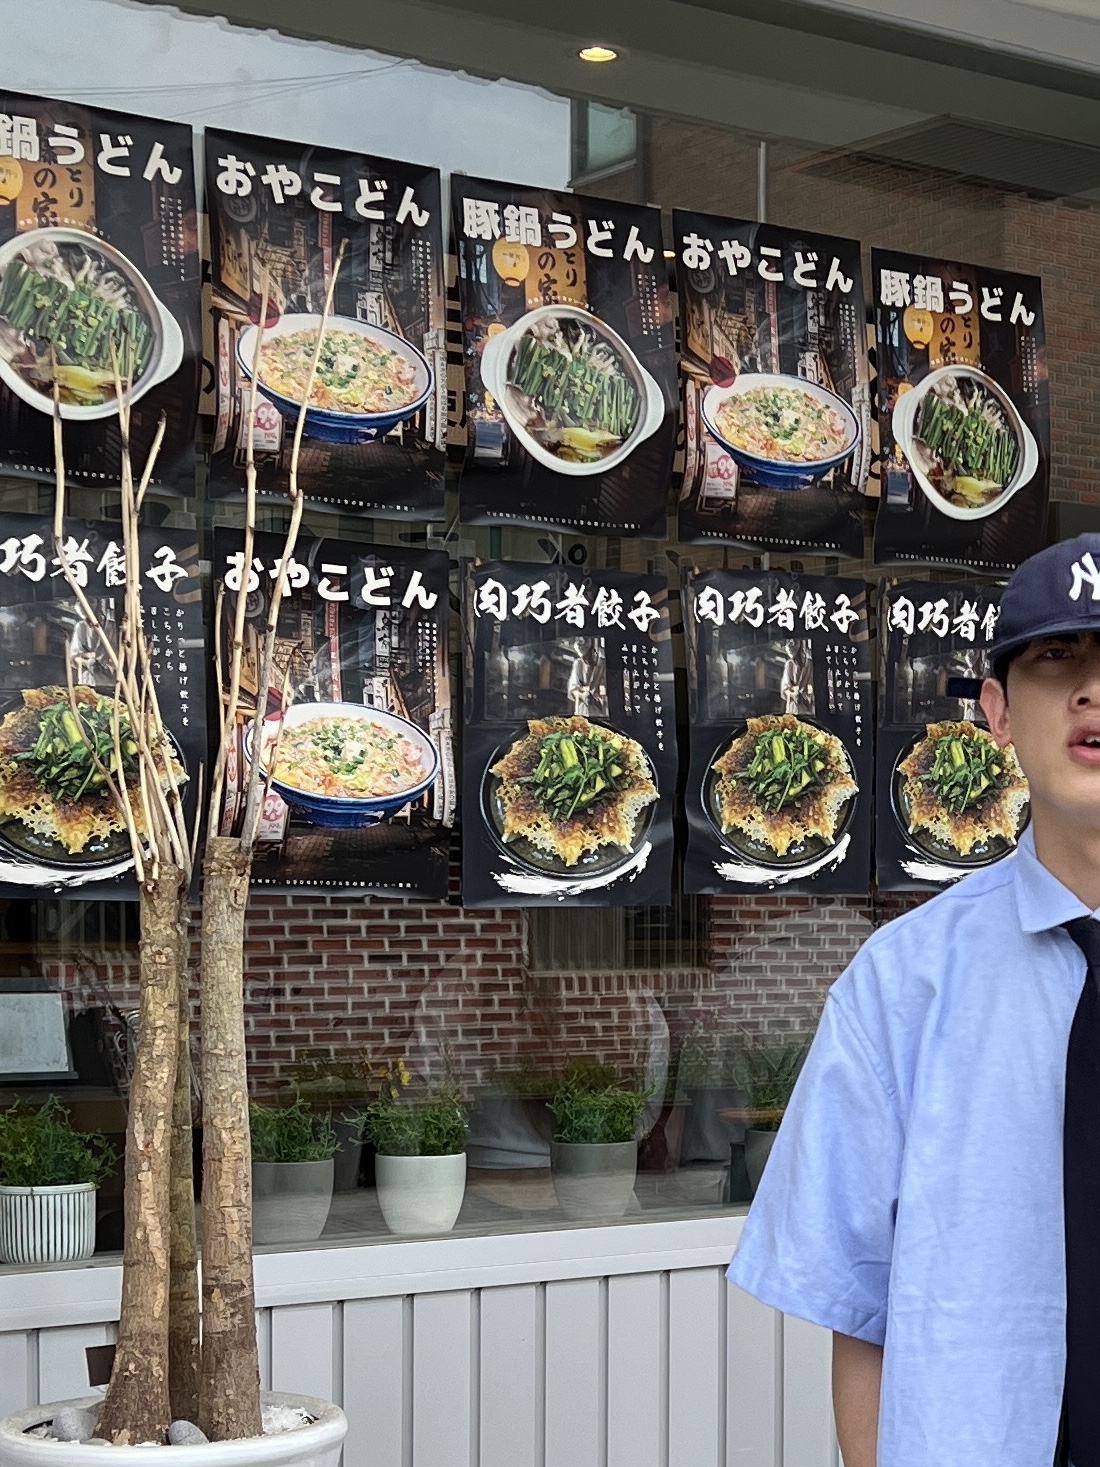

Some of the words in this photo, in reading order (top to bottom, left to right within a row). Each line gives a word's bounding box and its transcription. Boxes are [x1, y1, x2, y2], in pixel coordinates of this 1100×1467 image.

[216, 154, 430, 227] おやこどん
[462, 197, 655, 263] 豚鍋うどん
[682, 232, 853, 293] おやこどん
[880, 268, 1036, 326] 豚鍋うどん
[224, 551, 438, 610] おやこどん
[473, 577, 661, 632] 肉巧者餃子
[694, 585, 860, 633] 肉巧者餃子
